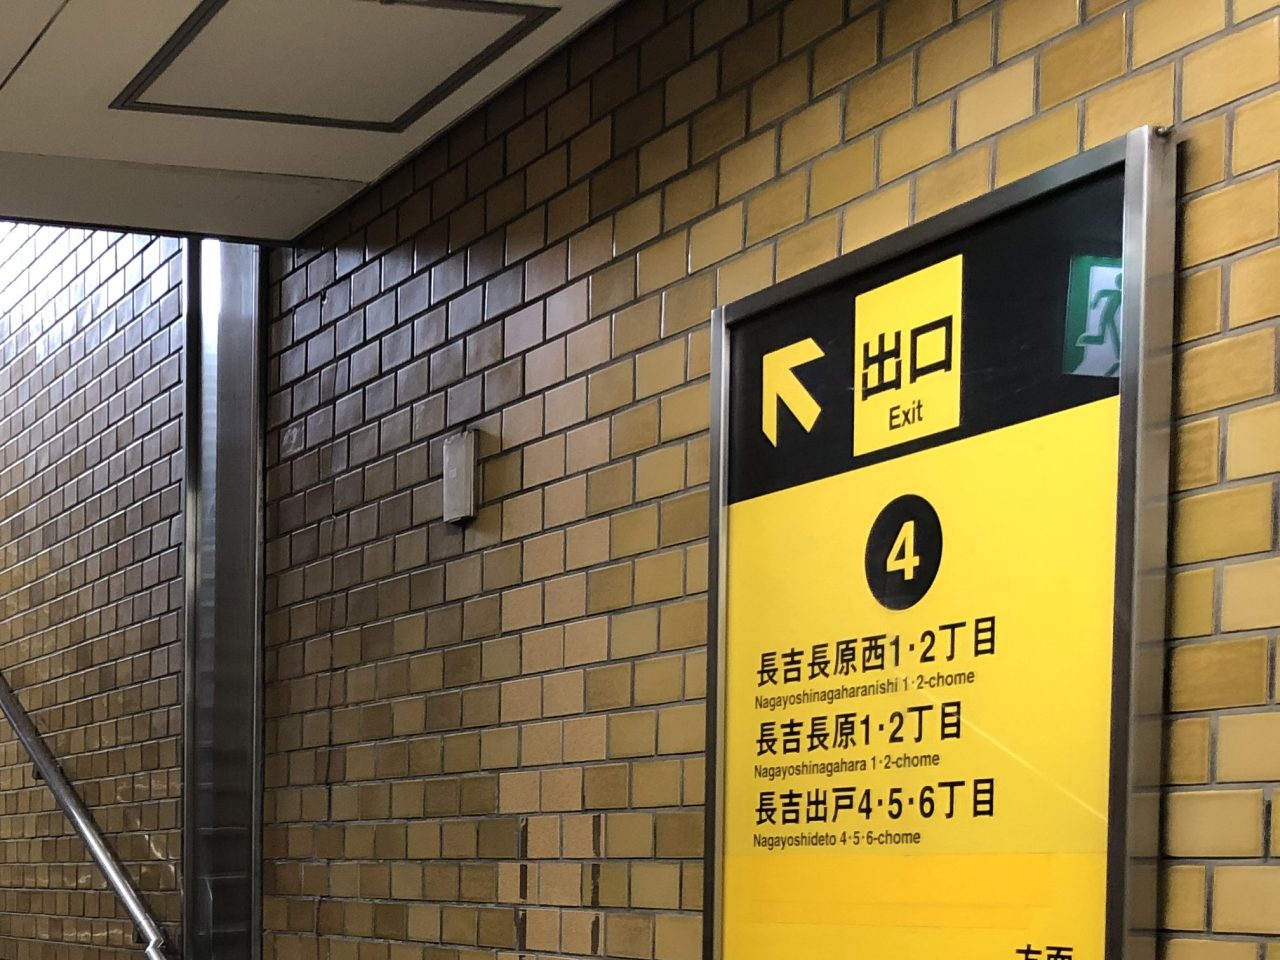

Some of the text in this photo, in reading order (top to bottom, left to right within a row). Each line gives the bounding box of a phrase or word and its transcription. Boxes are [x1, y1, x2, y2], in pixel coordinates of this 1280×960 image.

[861, 315, 953, 401] 出口
[888, 400, 924, 430] Exit
[886, 520, 920, 581] 4
[754, 677, 899, 710] Nagayoshinagaharanishi
[754, 757, 867, 780] Nagayoshinagahara
[753, 832, 837, 851] Nagayoshideto
